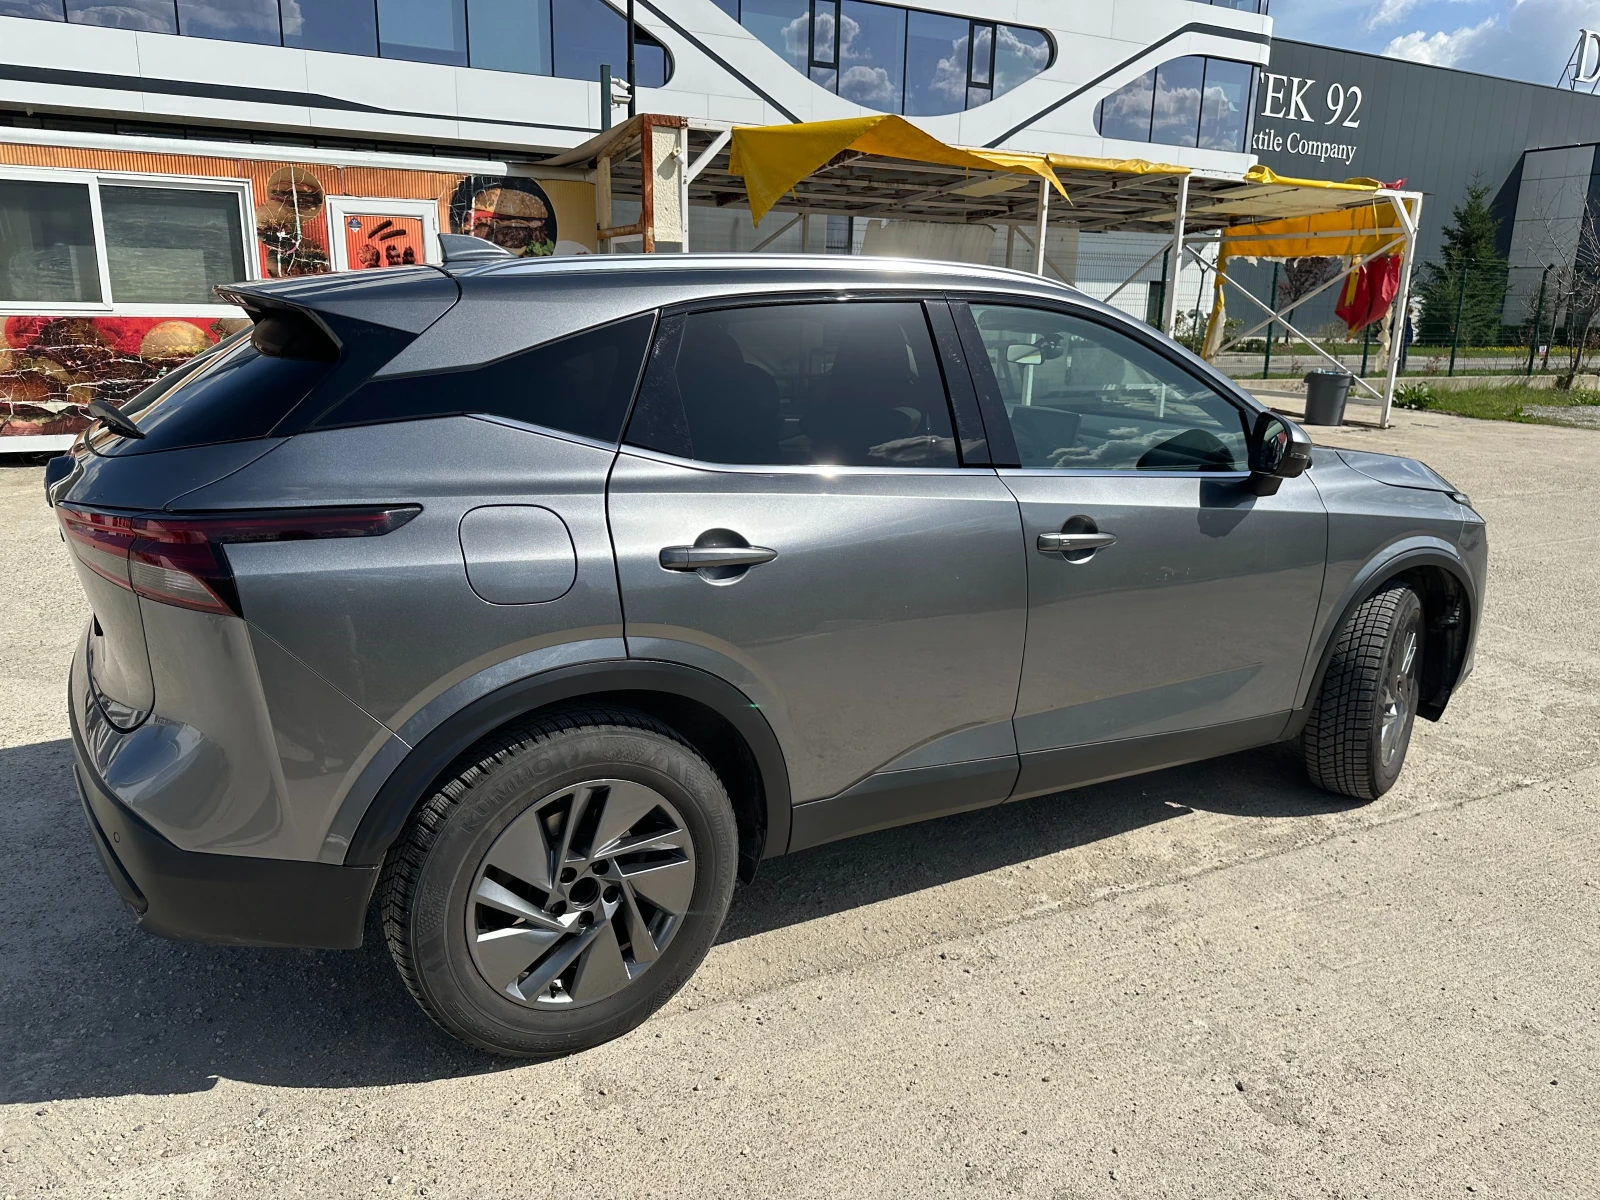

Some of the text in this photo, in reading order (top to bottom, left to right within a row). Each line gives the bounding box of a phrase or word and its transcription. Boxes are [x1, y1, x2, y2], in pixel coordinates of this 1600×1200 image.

[1260, 72, 1363, 129] EK 92
[1287, 132, 1357, 166] Company
[458, 753, 553, 836] KUMHO
